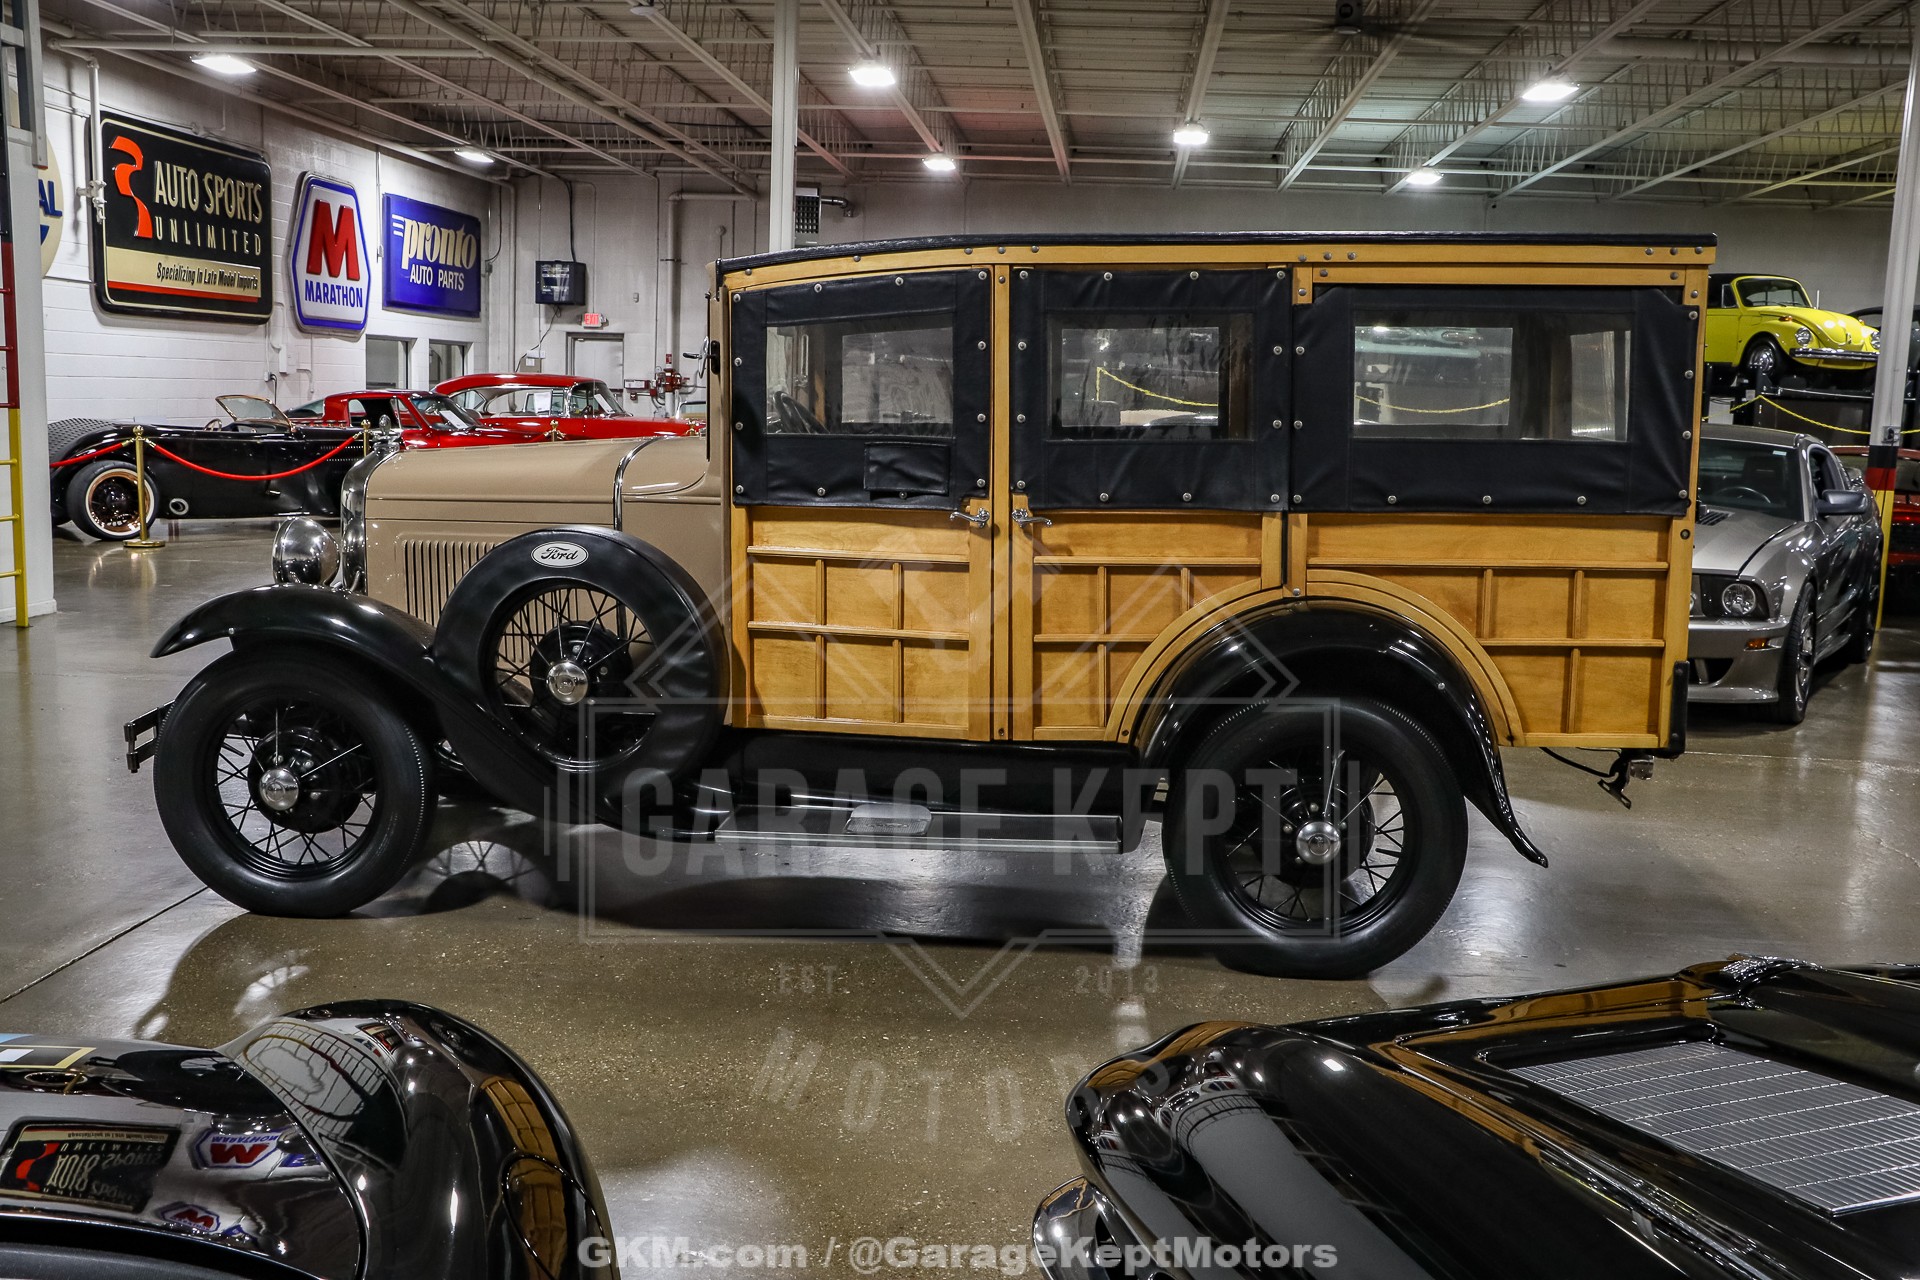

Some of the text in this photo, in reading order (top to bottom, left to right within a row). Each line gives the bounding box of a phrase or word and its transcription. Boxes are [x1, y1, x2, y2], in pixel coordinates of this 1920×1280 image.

[155, 160, 263, 224] AUTO SPORTS
[155, 216, 261, 256] UNLIMITED
[306, 198, 361, 281] M
[401, 217, 477, 270] pronto
[157, 262, 196, 285] Specializing
[204, 268, 217, 285] Late
[218, 269, 236, 288] Model
[409, 264, 465, 292] AUTO PARTS
[304, 279, 363, 308] MARATHON
[584, 313, 599, 325] EXIT
[541, 546, 578, 560] Ford
